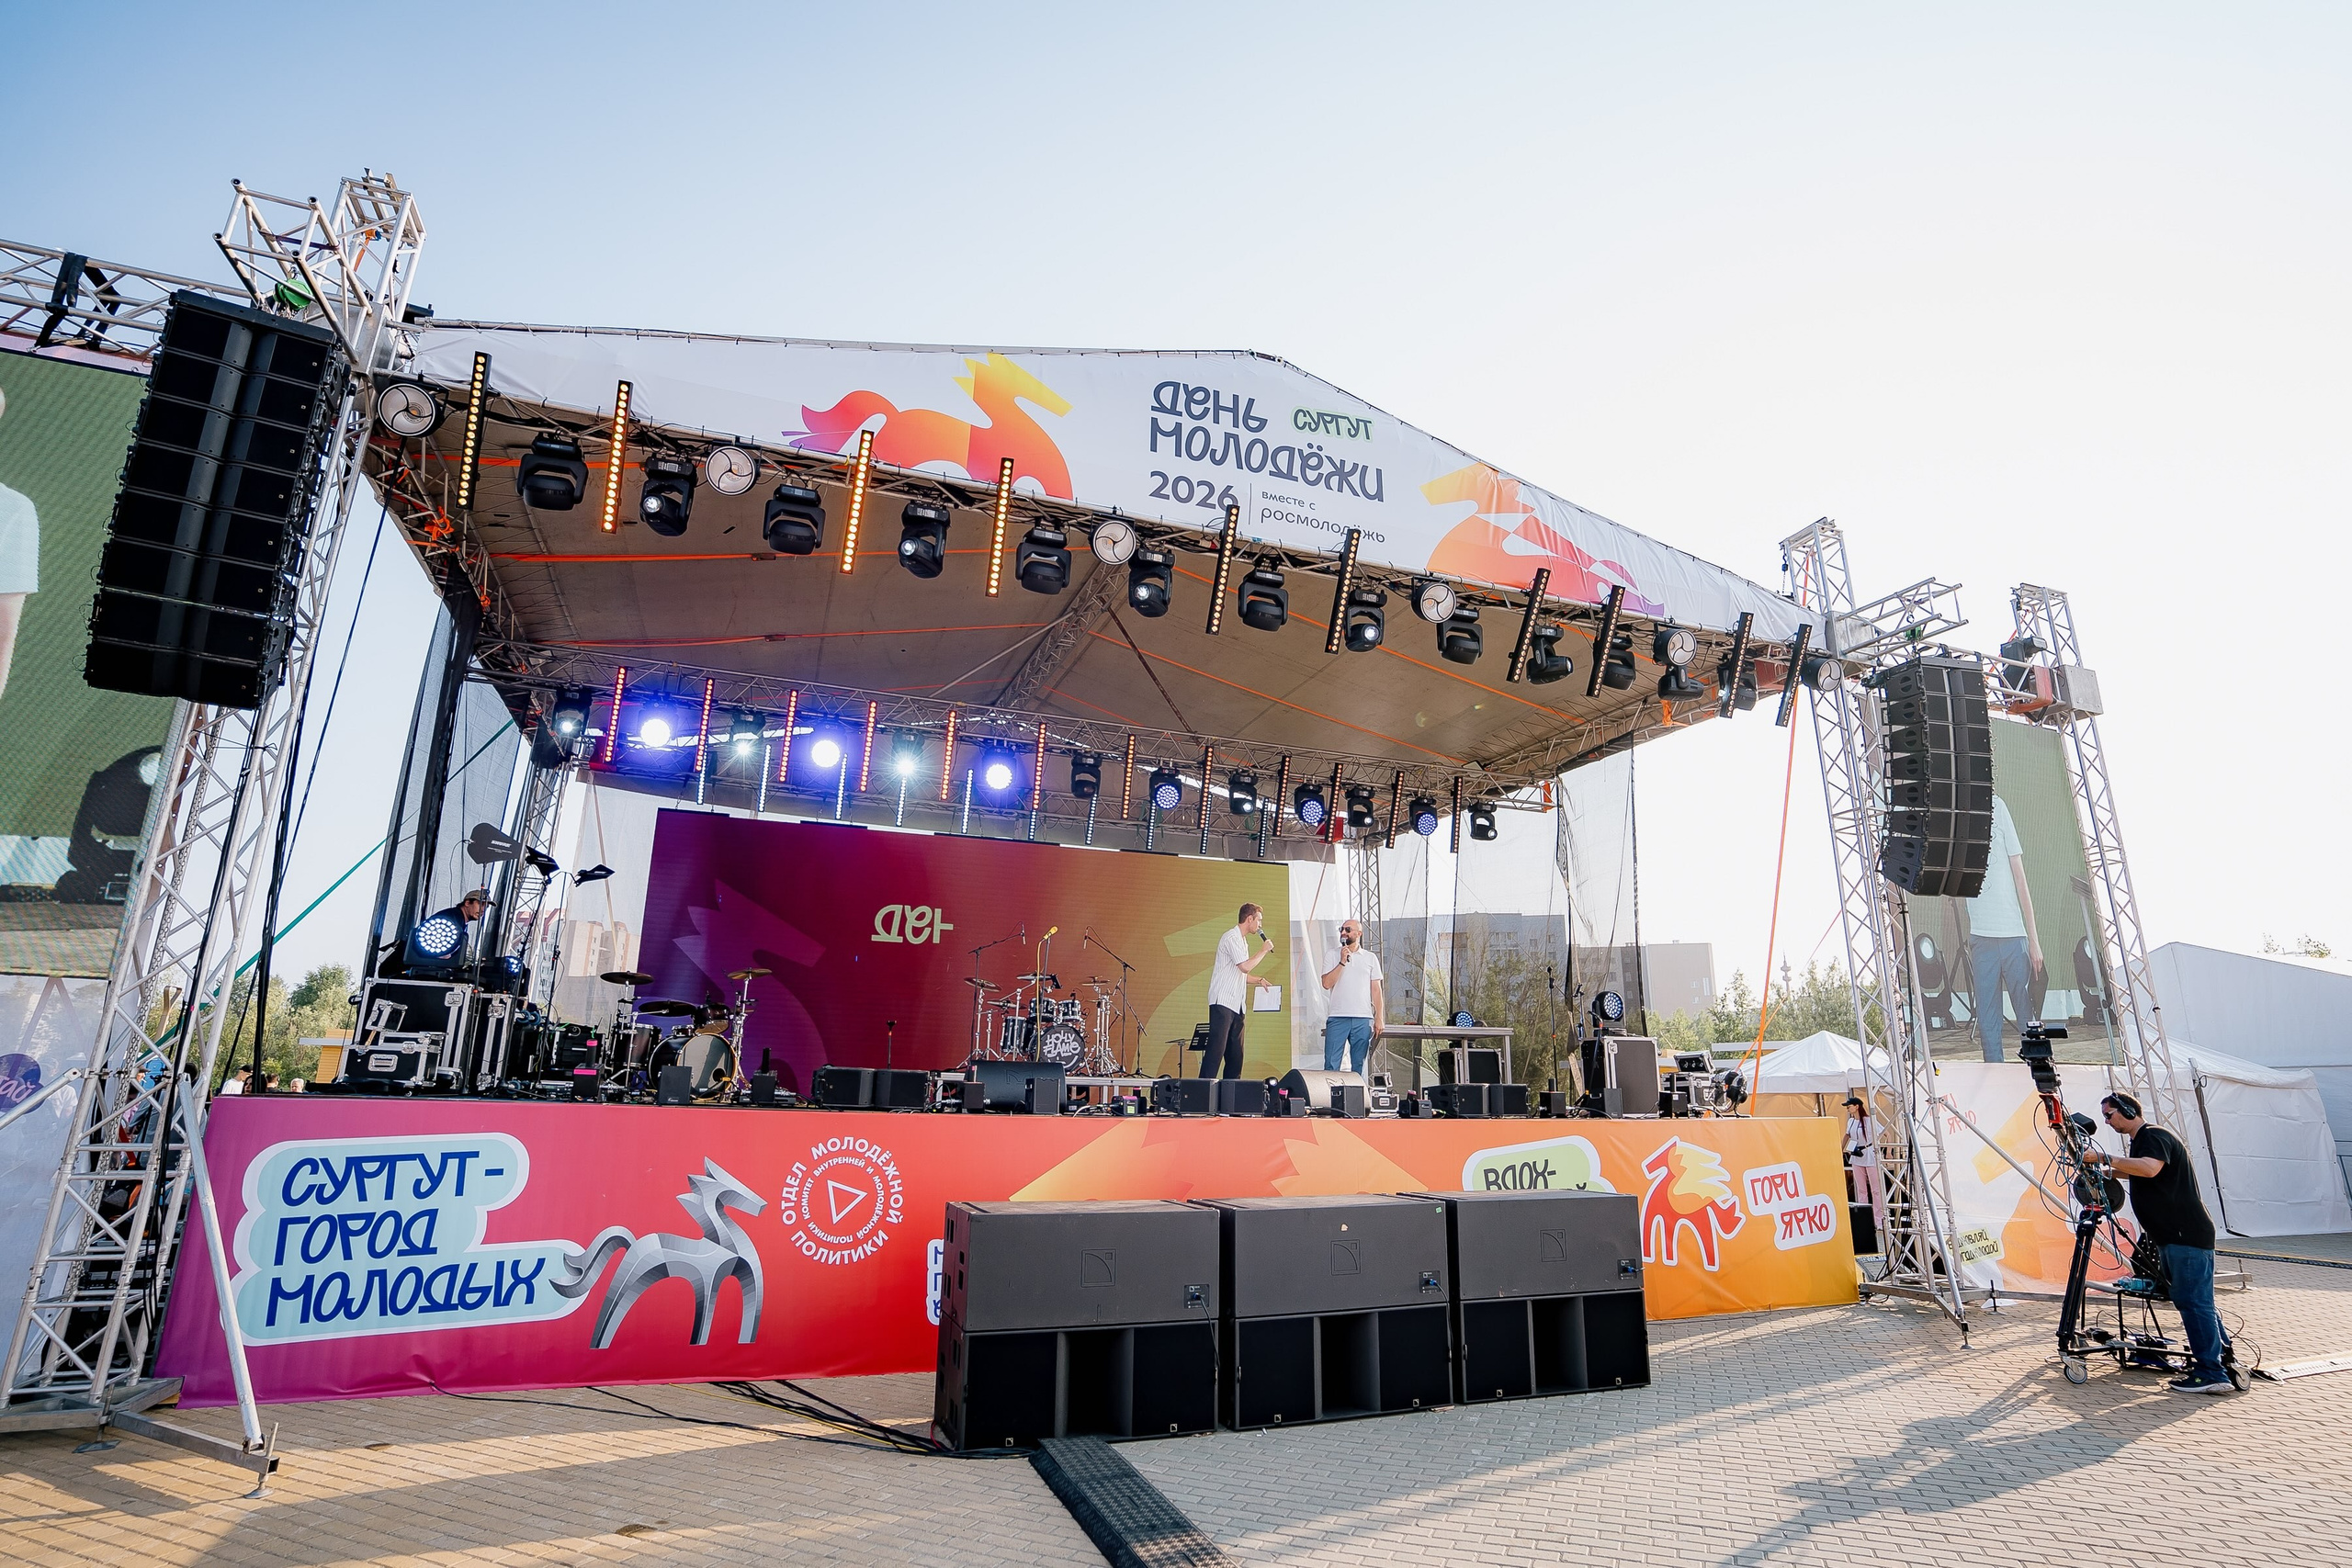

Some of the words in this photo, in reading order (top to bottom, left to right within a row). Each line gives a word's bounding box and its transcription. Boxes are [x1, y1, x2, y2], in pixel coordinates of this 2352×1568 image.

[1293, 408, 1374, 441] СУРГУТ
[1148, 470, 1238, 512] 2026
[1261, 491, 1305, 508] вместе
[1309, 502, 1317, 511] с
[810, 1136, 904, 1225] МОЛОДЁЖНОЙ
[812, 1156, 866, 1178] ВНУТРЕННЕЙ
[865, 1166, 875, 1175] И
[780, 1161, 808, 1225] ОТДЕЛ
[801, 1177, 815, 1220] КОМИТЕТ
[1750, 1171, 1800, 1206] ГОРИ
[273, 1207, 439, 1267] ГОРОД
[808, 1221, 854, 1244] ПОЛИТИКИ
[1781, 1203, 1830, 1240] ЯРКО
[790, 1229, 889, 1266] ПОЛИТИКИ
[265, 1257, 547, 1328] МОЛОДЫХ
